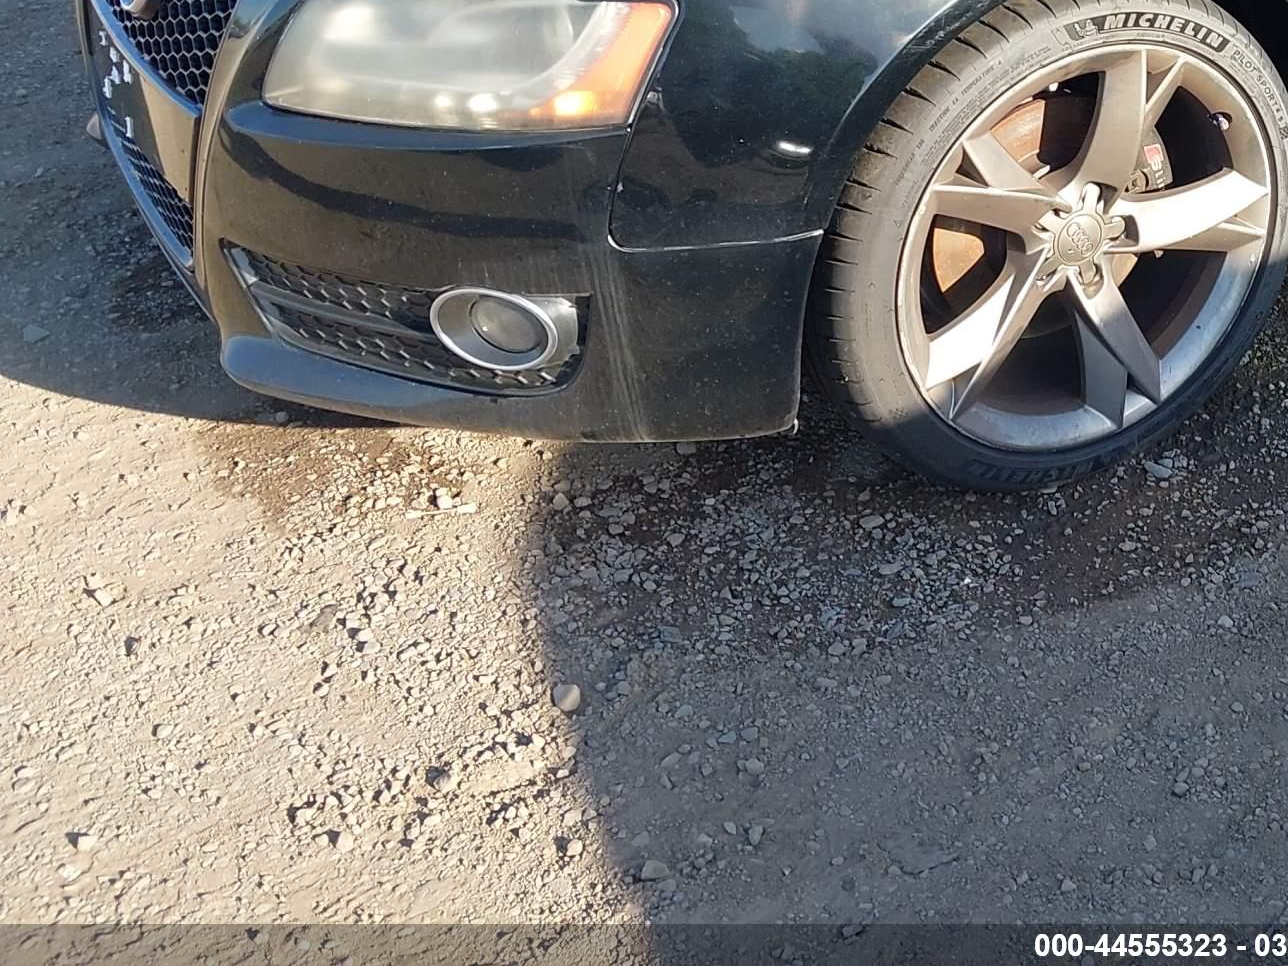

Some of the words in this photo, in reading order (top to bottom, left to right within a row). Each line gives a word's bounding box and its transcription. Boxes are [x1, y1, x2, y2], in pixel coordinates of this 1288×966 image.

[1103, 13, 1224, 50] MICHELIN
[1232, 50, 1258, 73] PILOT
[1256, 74, 1279, 110] SPORT
